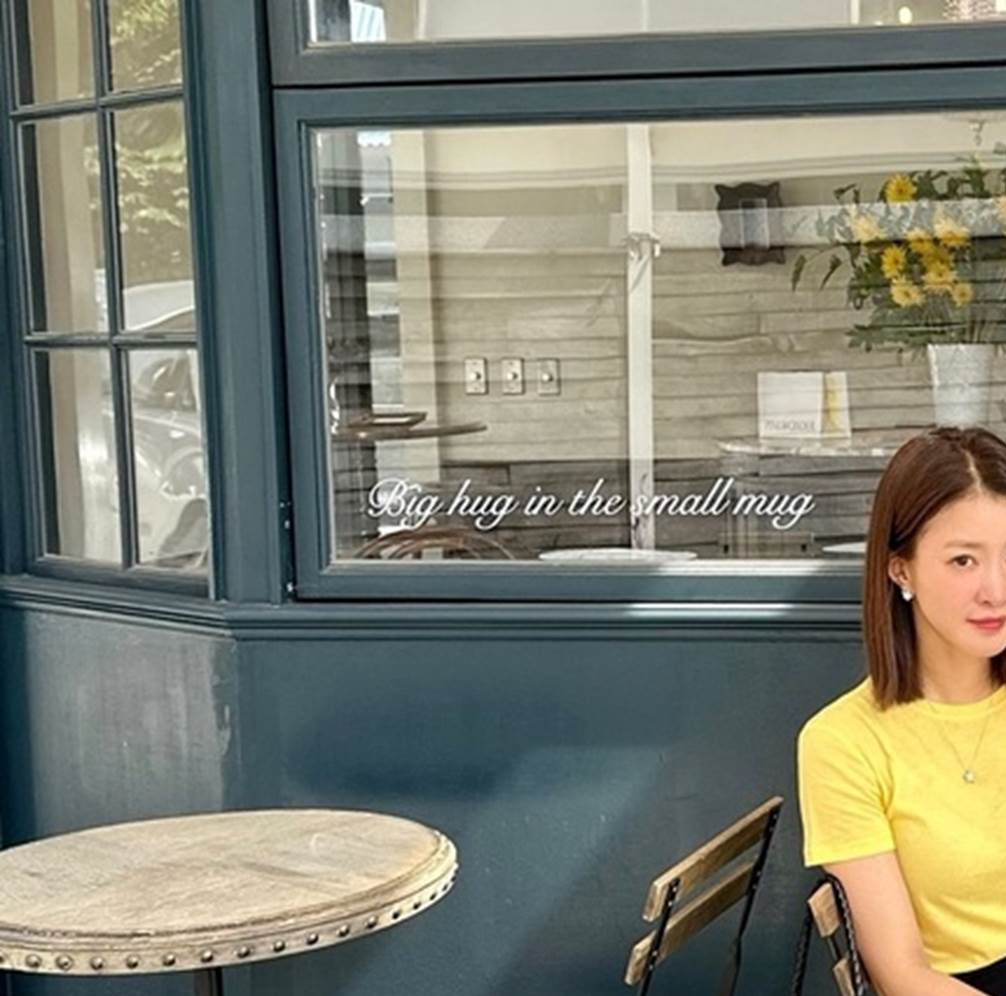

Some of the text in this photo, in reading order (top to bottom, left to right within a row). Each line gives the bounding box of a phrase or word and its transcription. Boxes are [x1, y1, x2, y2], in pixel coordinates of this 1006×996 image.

[368, 477, 816, 530] Big hug in the small mug
